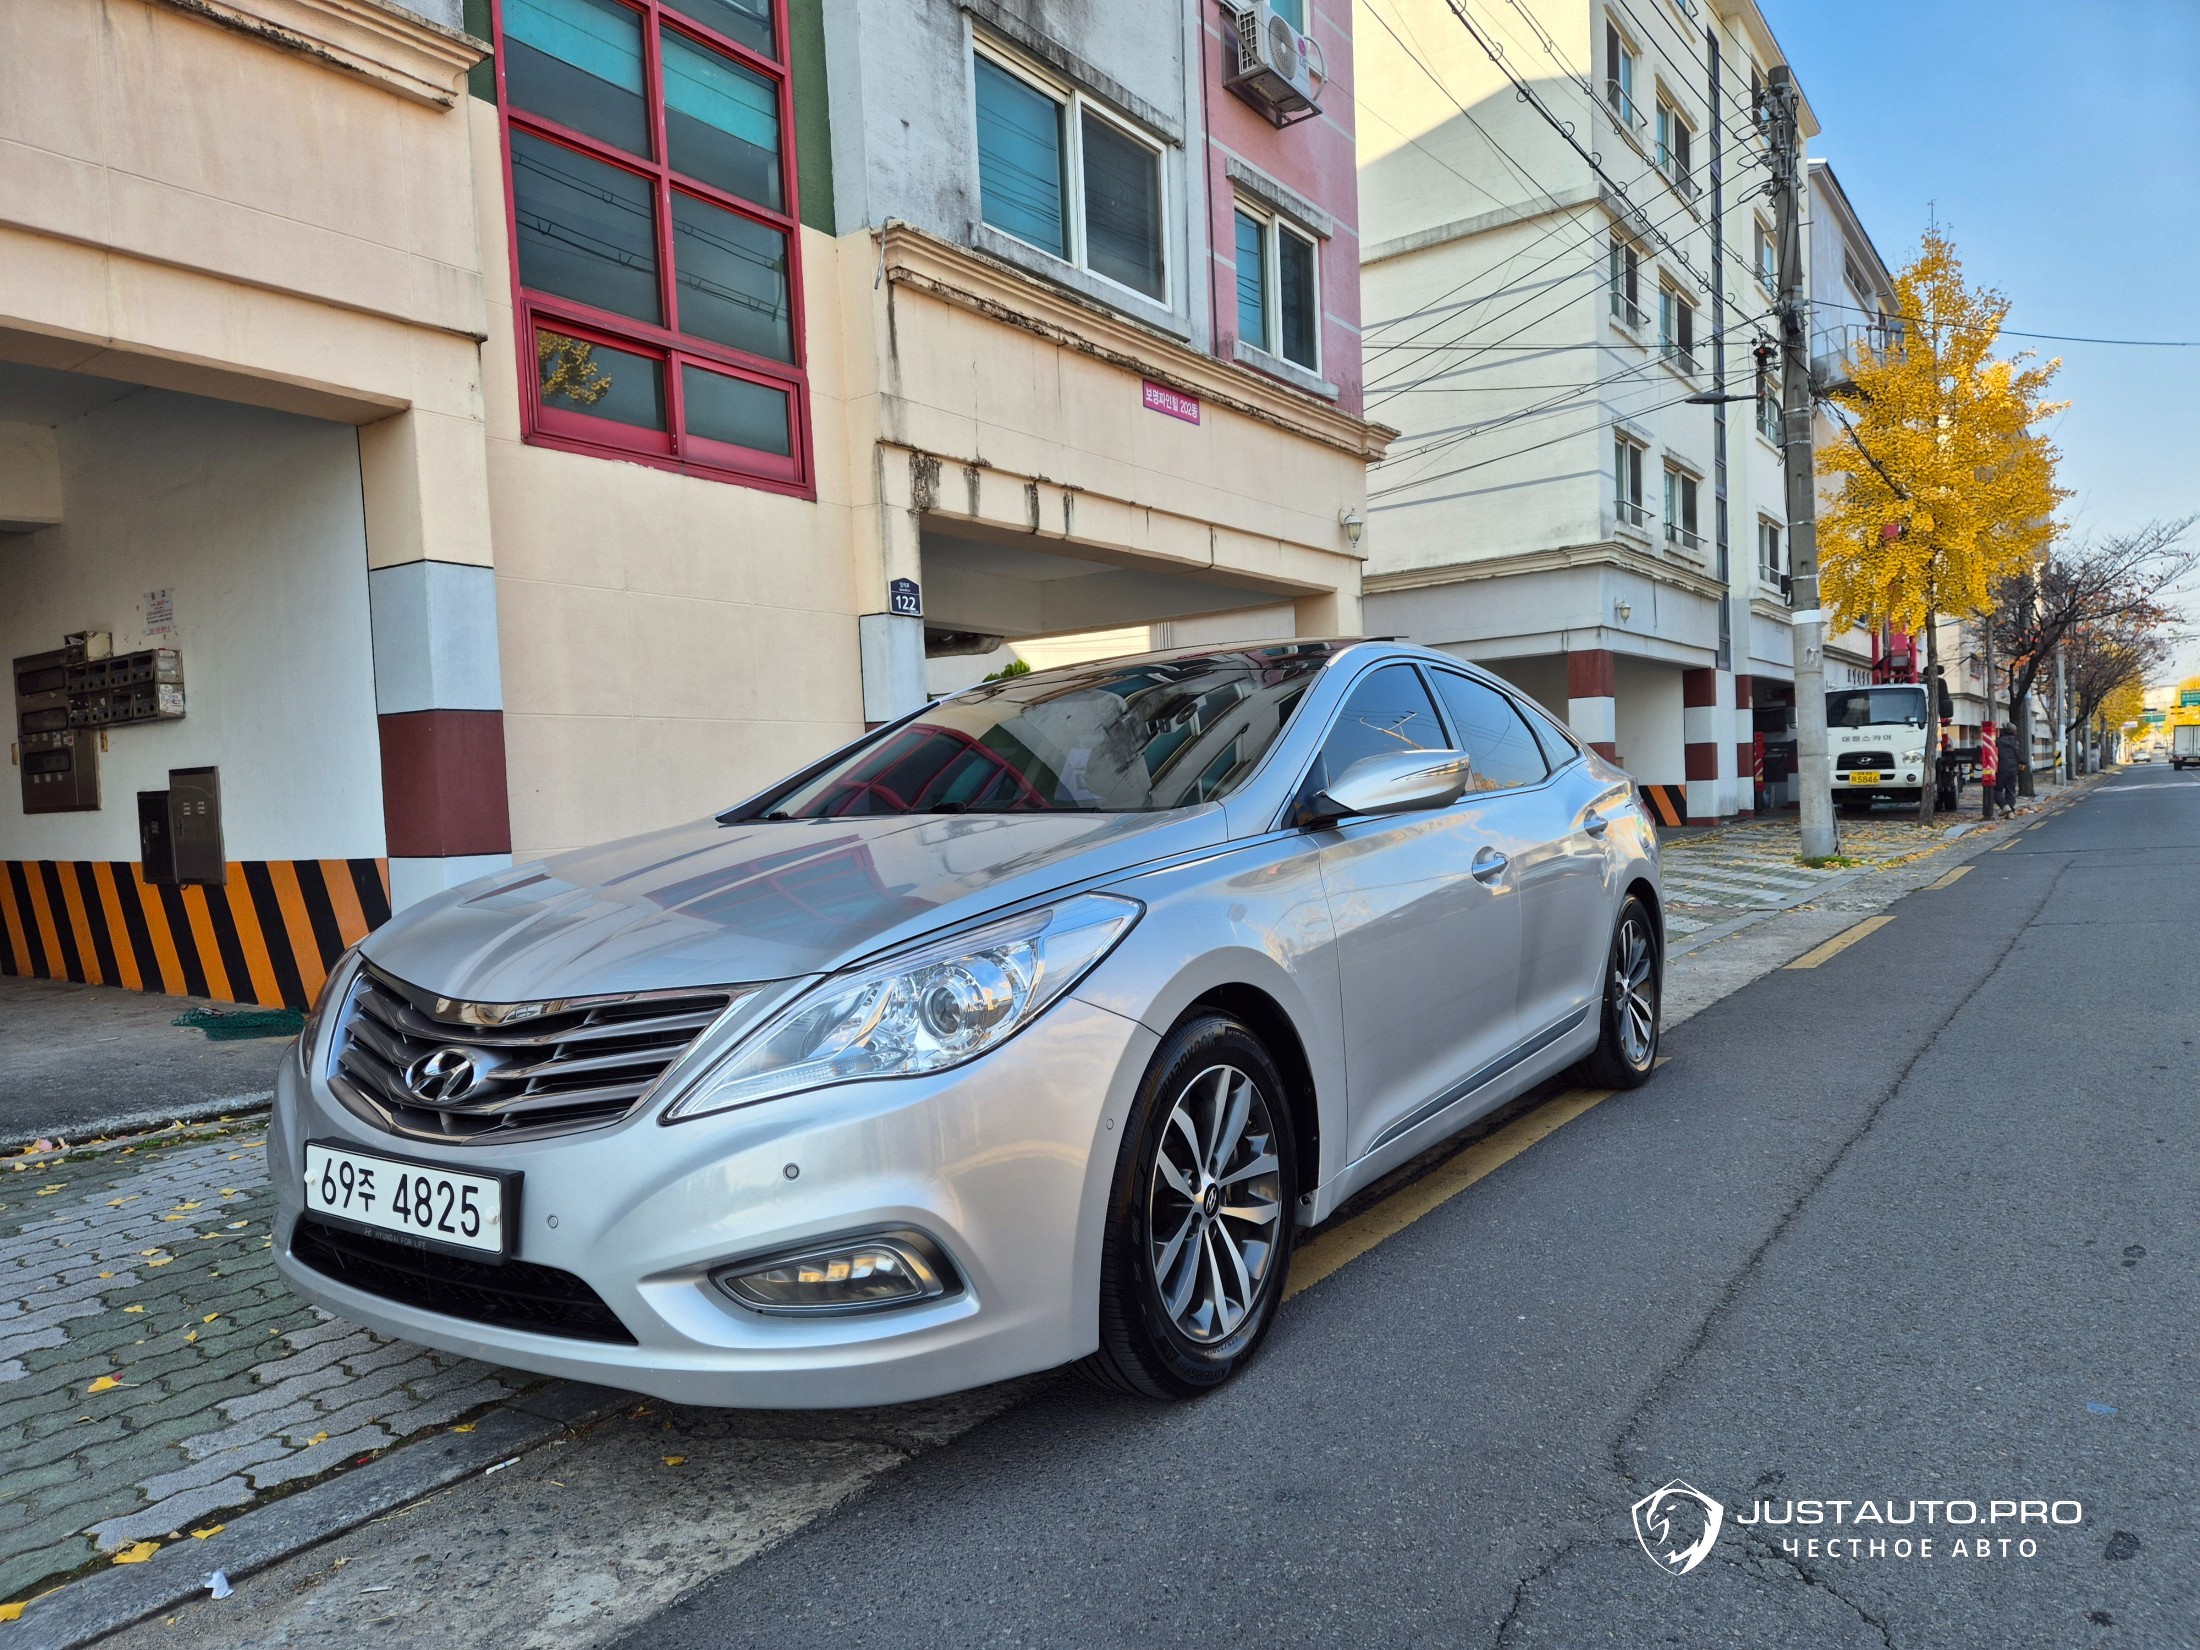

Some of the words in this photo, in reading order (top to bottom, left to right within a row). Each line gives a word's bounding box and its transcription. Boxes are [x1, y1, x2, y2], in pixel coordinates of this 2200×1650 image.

[1180, 399, 1198, 419] 202동
[895, 594, 917, 611] 122
[1857, 775, 1878, 783] 5846
[321, 1157, 376, 1212] 69주
[392, 1173, 480, 1238] 4825
[374, 1231, 399, 1243] HYUNDAI
[400, 1236, 412, 1246] FOR
[414, 1240, 427, 1250] LIFE
